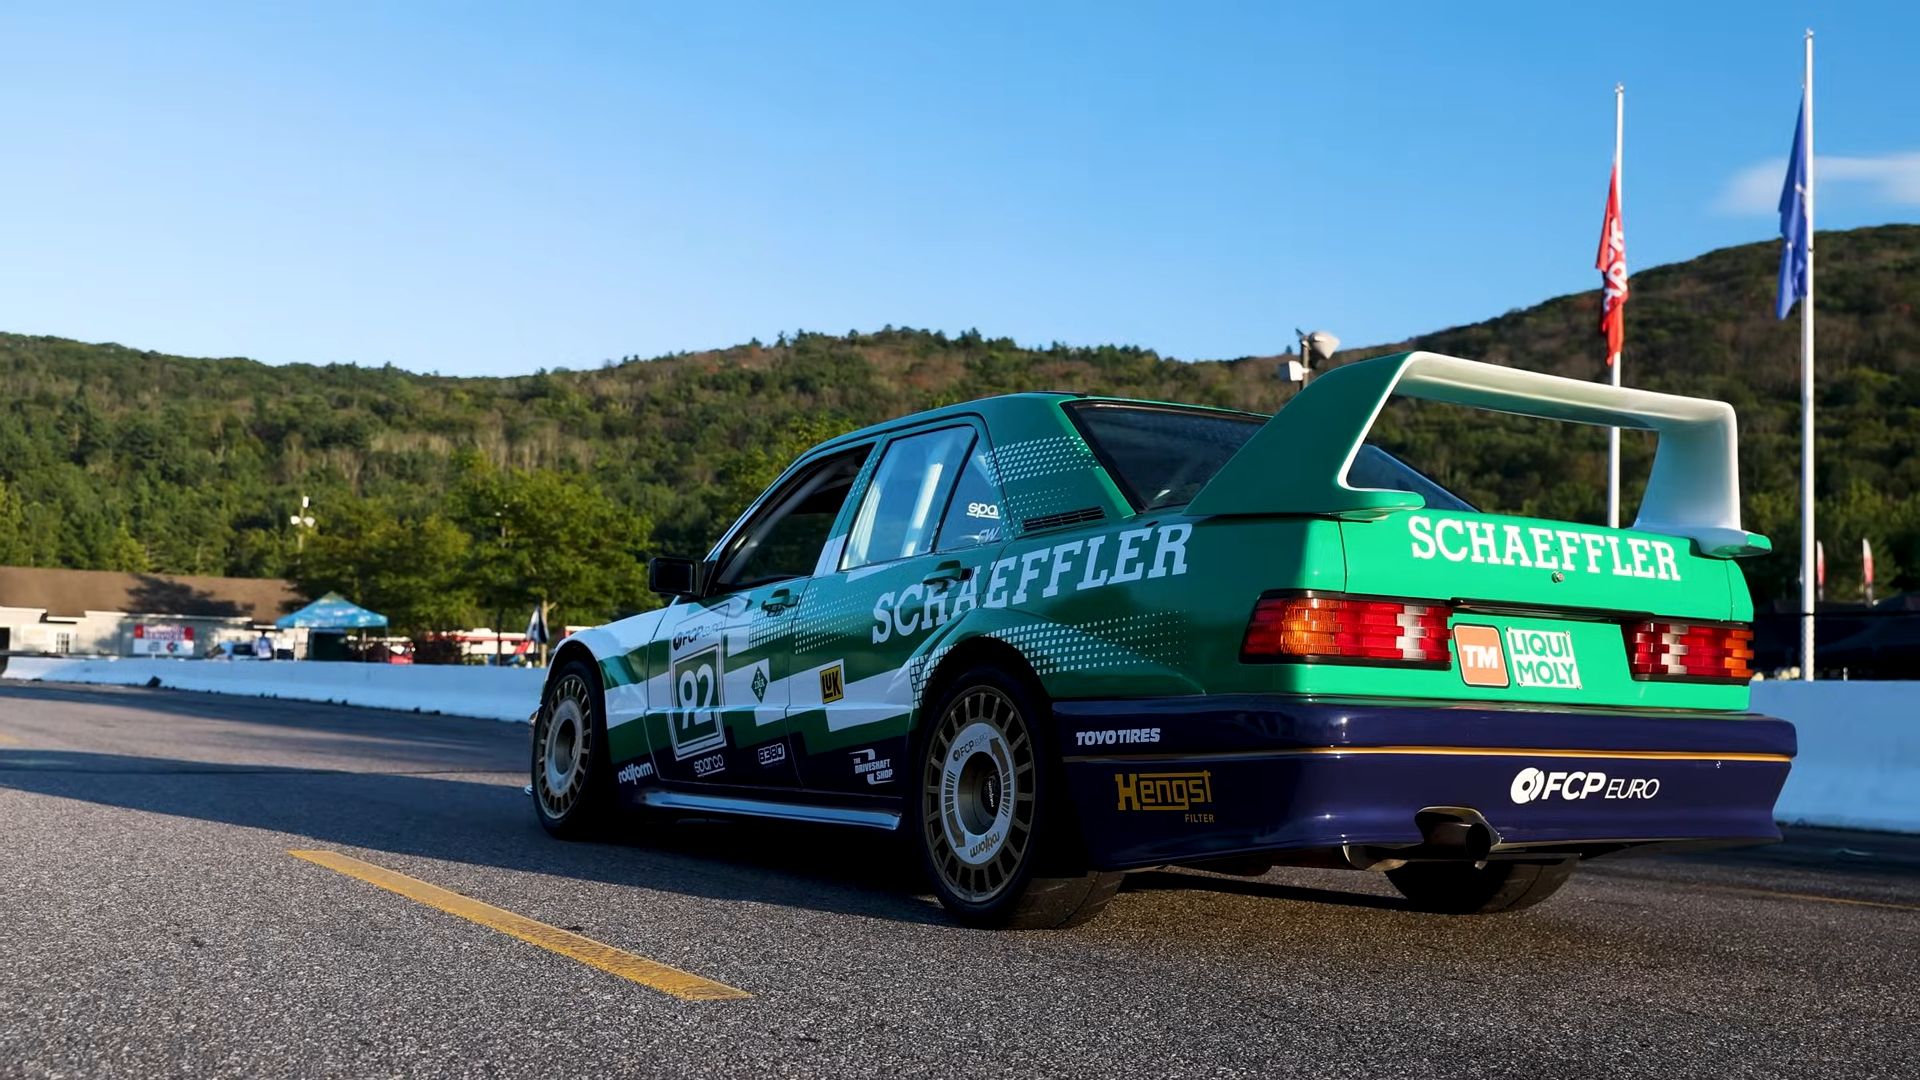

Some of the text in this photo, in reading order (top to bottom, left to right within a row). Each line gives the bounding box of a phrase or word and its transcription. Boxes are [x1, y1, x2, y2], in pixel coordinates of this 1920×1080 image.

[1408, 516, 1681, 581] SCHAEFFLER
[872, 523, 1193, 645] SCHAEFFLER
[1463, 644, 1498, 669] TM
[1510, 632, 1570, 658] LIQUI
[1516, 661, 1574, 685] MOLY
[679, 663, 714, 730] 92
[1076, 728, 1161, 746] TOYO TIRES
[694, 754, 724, 774] sparco
[876, 769, 893, 780] SHOP
[1115, 770, 1213, 811] Hengst
[1541, 771, 1660, 800] FCP EURO
[1185, 814, 1214, 823] FILTER
